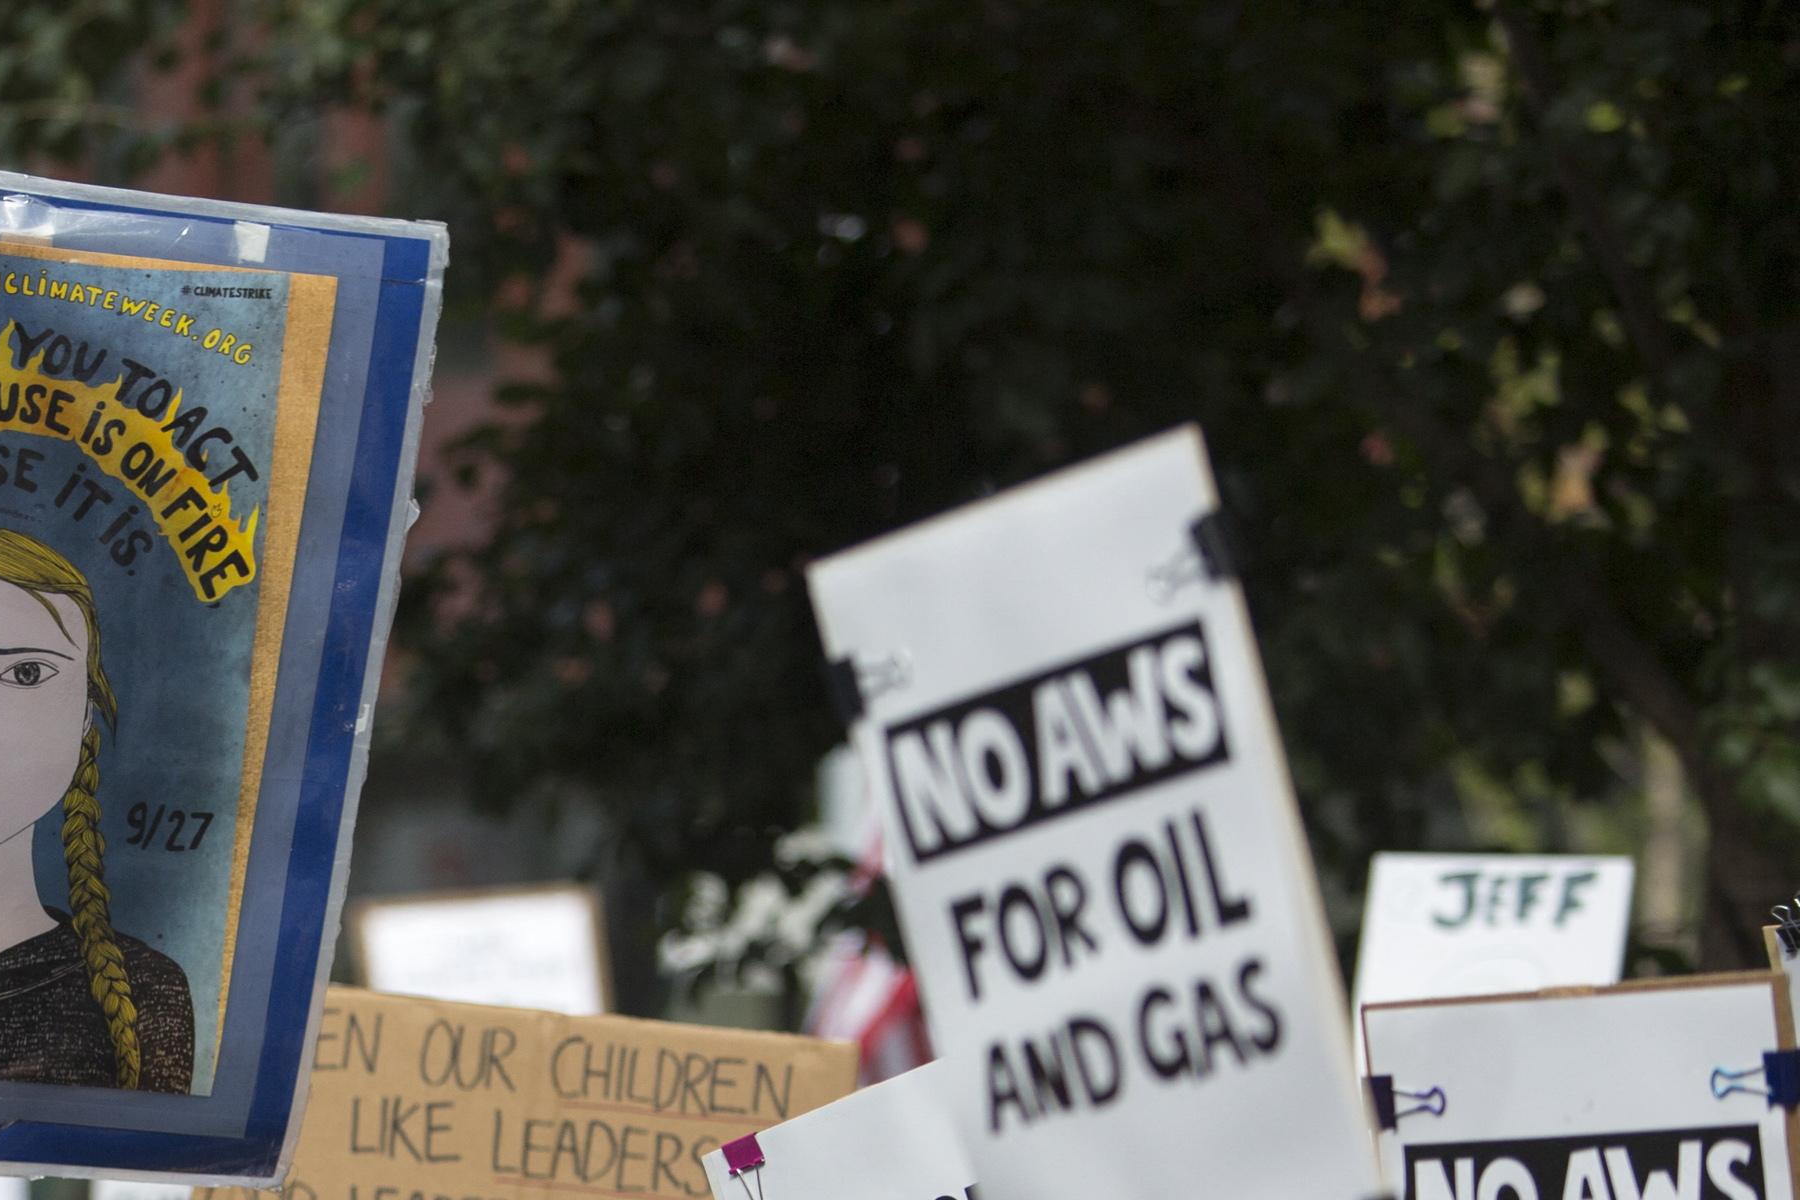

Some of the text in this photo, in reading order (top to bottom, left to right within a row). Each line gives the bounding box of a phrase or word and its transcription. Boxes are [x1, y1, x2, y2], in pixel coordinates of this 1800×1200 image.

[14, 325, 106, 385] YOU
[120, 357, 172, 421] TO
[162, 406, 260, 488] ACT
[120, 441, 168, 498] ON
[890, 632, 1218, 856] NO AWS
[126, 802, 213, 852] 9/27
[950, 810, 1252, 1003] FOR OIL
[1431, 869, 1600, 928] JEFF
[312, 1007, 794, 1119] EN OUR CHILDREN
[984, 957, 1286, 1133] AND GAS
[350, 1095, 715, 1198] LIKE LEADERS
